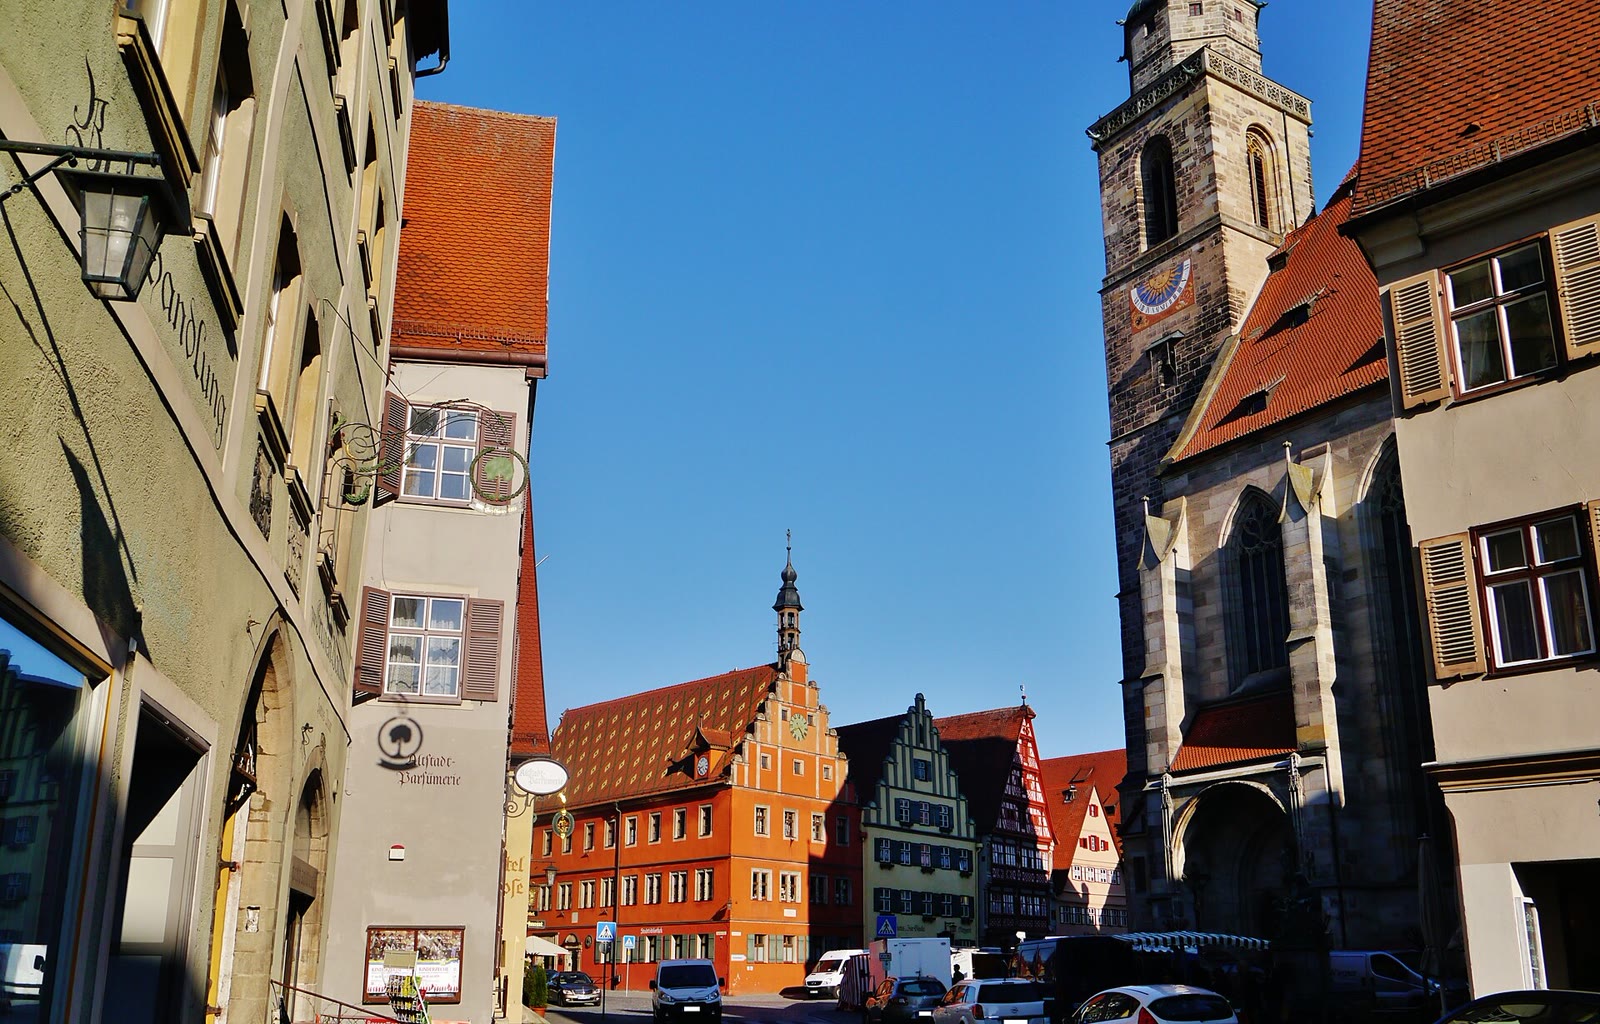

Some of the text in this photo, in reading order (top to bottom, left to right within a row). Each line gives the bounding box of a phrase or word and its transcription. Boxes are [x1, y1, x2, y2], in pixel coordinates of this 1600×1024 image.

[398, 771, 461, 789] Parfümerie
[505, 856, 525, 872] tel
[504, 878, 524, 899] ose
